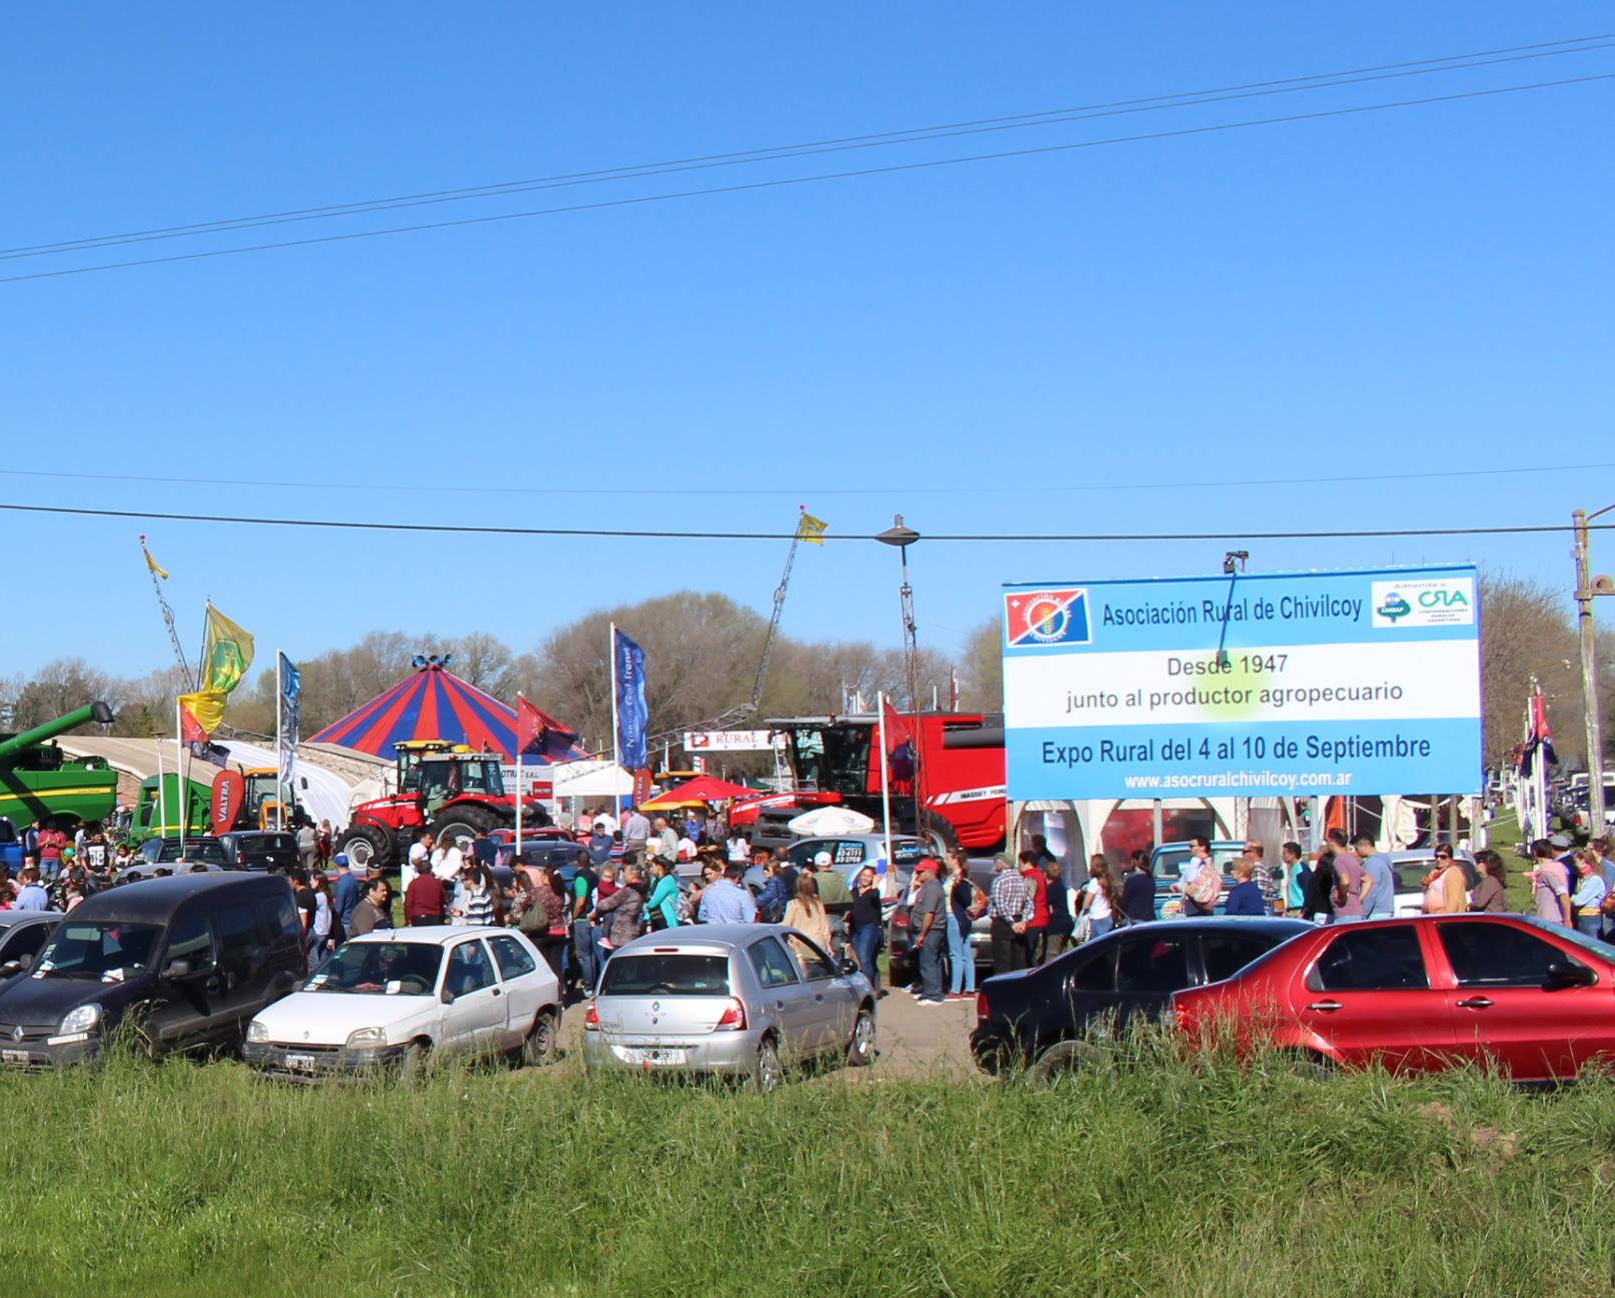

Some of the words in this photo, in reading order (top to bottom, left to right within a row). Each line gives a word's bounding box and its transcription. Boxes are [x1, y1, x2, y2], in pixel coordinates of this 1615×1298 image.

[1103, 600, 1197, 627] Asociación
[1202, 598, 1248, 623] Rural
[1253, 596, 1275, 621] de
[1280, 594, 1362, 623] Chivilcoy
[1168, 656, 1232, 676] Desde
[1240, 654, 1289, 674] 1947
[1066, 689, 1119, 713] junto
[1125, 688, 1142, 708] al
[1149, 685, 1252, 711] productor
[1259, 681, 1404, 709] agropecuario
[715, 734, 759, 744] RURAL
[1042, 740, 1093, 768] Expo
[1101, 739, 1153, 763] Rural
[1161, 737, 1191, 761] del
[1198, 737, 1211, 761] 4
[1217, 736, 1234, 761] al
[1243, 735, 1266, 760] 10
[1273, 735, 1298, 760] de
[1306, 733, 1431, 763] Septiembre
[1124, 770, 1352, 790] www.asocruralchivilcoy.com.ar
[218, 780, 230, 822] VALTRA
